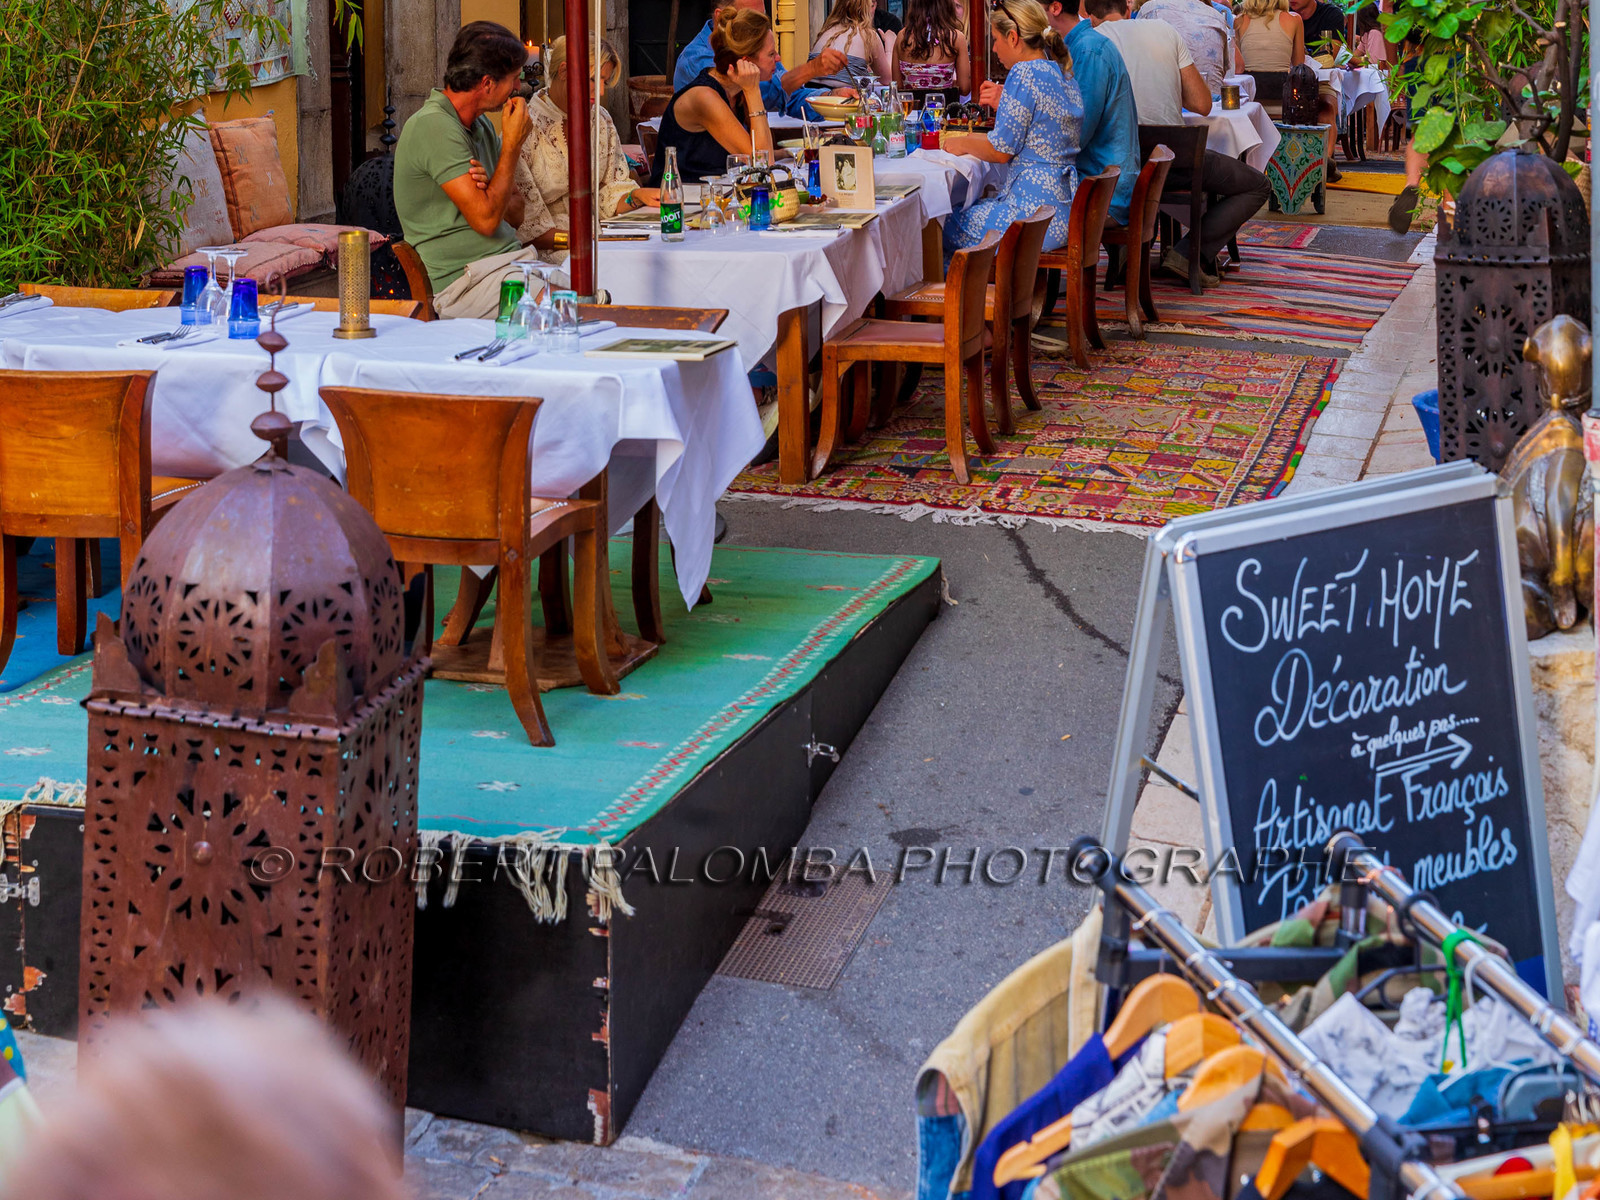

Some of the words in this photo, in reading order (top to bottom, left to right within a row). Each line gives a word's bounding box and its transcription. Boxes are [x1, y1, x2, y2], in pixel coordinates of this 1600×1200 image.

[1220, 548, 1370, 653] SWEET
[1379, 549, 1480, 649] HOME
[1254, 645, 1468, 747] Décoration
[1351, 731, 1370, 758] à
[1366, 715, 1426, 770] quelques
[1253, 772, 1395, 886] Artisanat
[1401, 756, 1509, 825] Français
[1413, 815, 1518, 892] meubles
